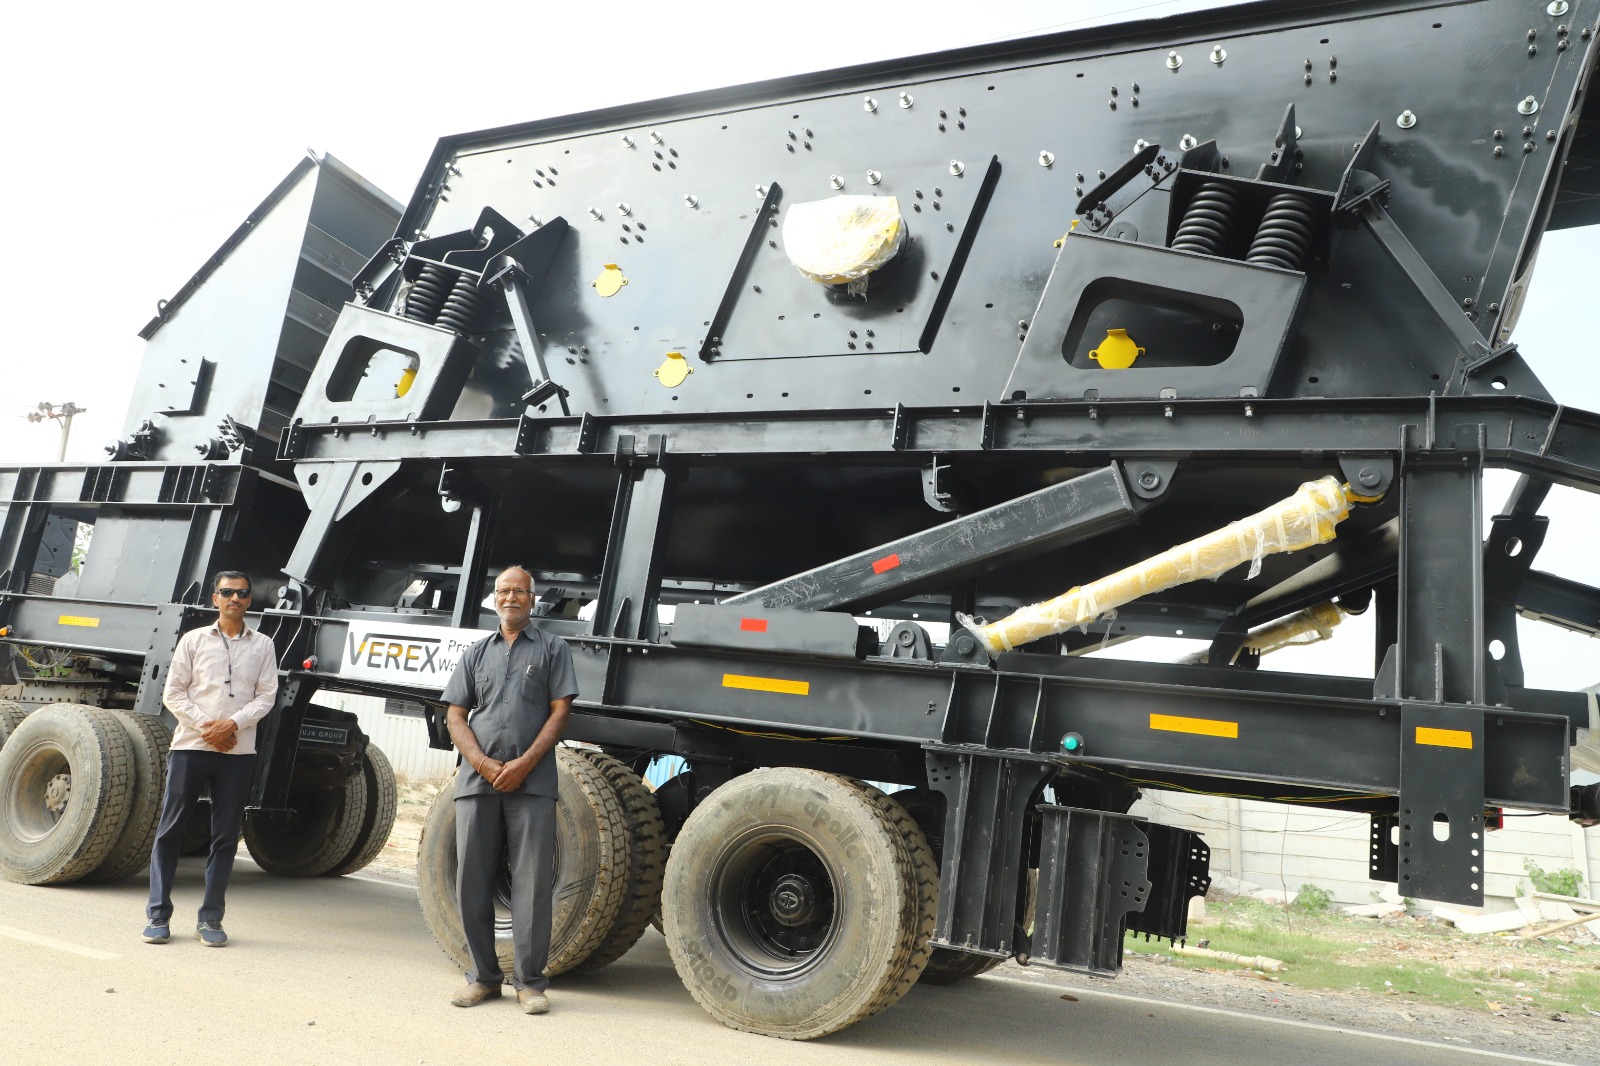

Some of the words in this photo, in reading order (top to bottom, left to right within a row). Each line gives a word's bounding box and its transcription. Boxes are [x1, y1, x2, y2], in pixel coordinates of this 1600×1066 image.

[350, 632, 441, 673] VEREX
[447, 639, 475, 654] Pro
[301, 729, 316, 737] UJA
[318, 730, 343, 740] GROUP
[803, 801, 860, 860] apollo
